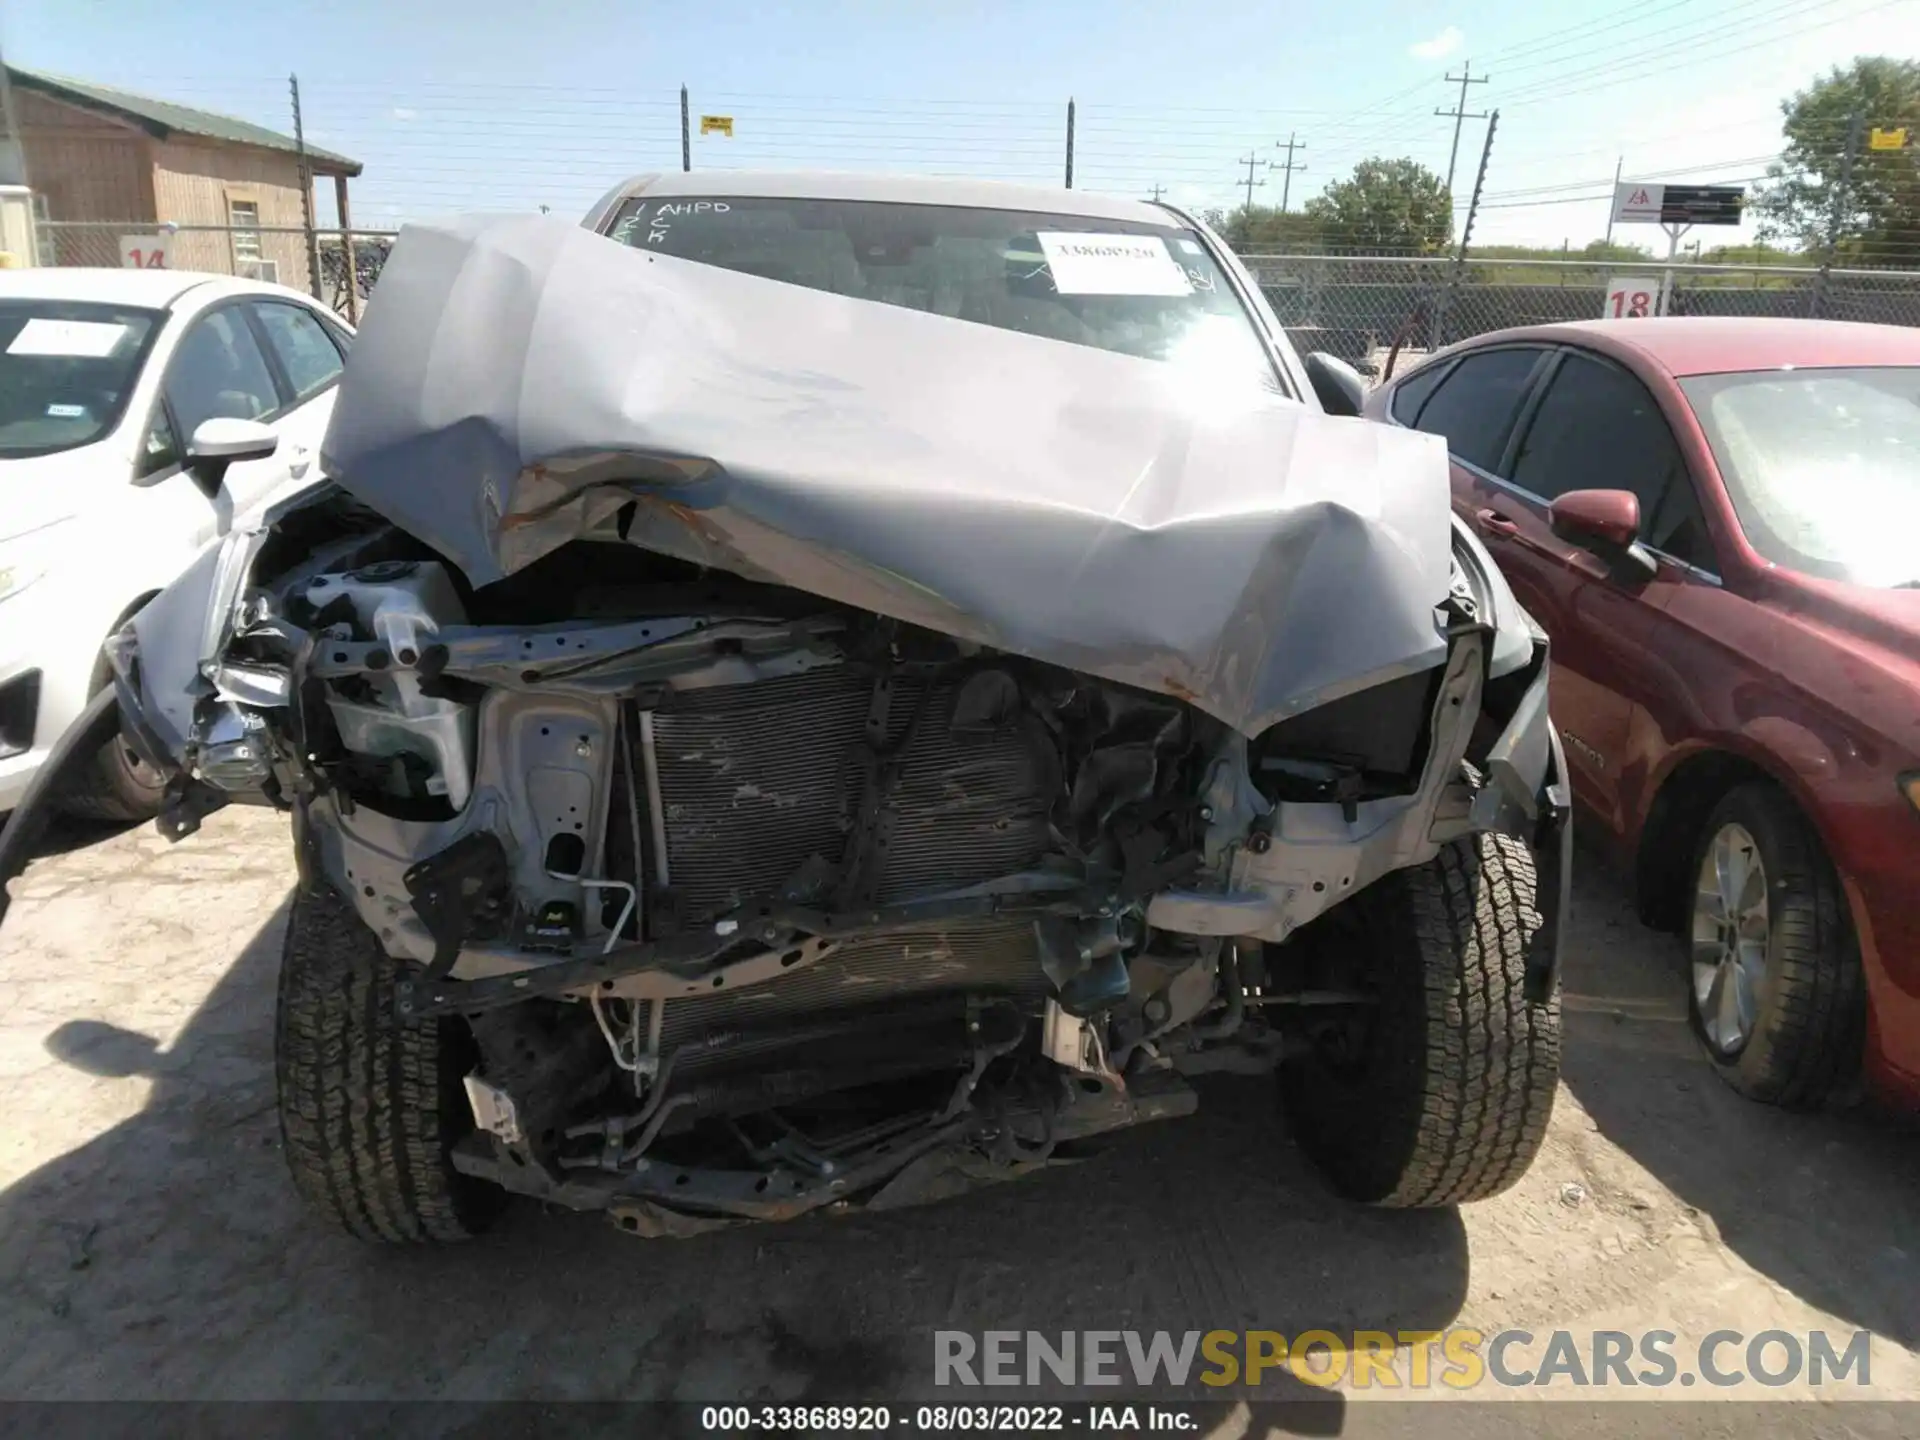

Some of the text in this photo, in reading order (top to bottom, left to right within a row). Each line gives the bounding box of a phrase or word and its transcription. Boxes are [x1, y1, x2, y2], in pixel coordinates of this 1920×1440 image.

[656, 201, 731, 216] AHPD
[128, 248, 170, 269] 14
[1611, 291, 1651, 317] 18
